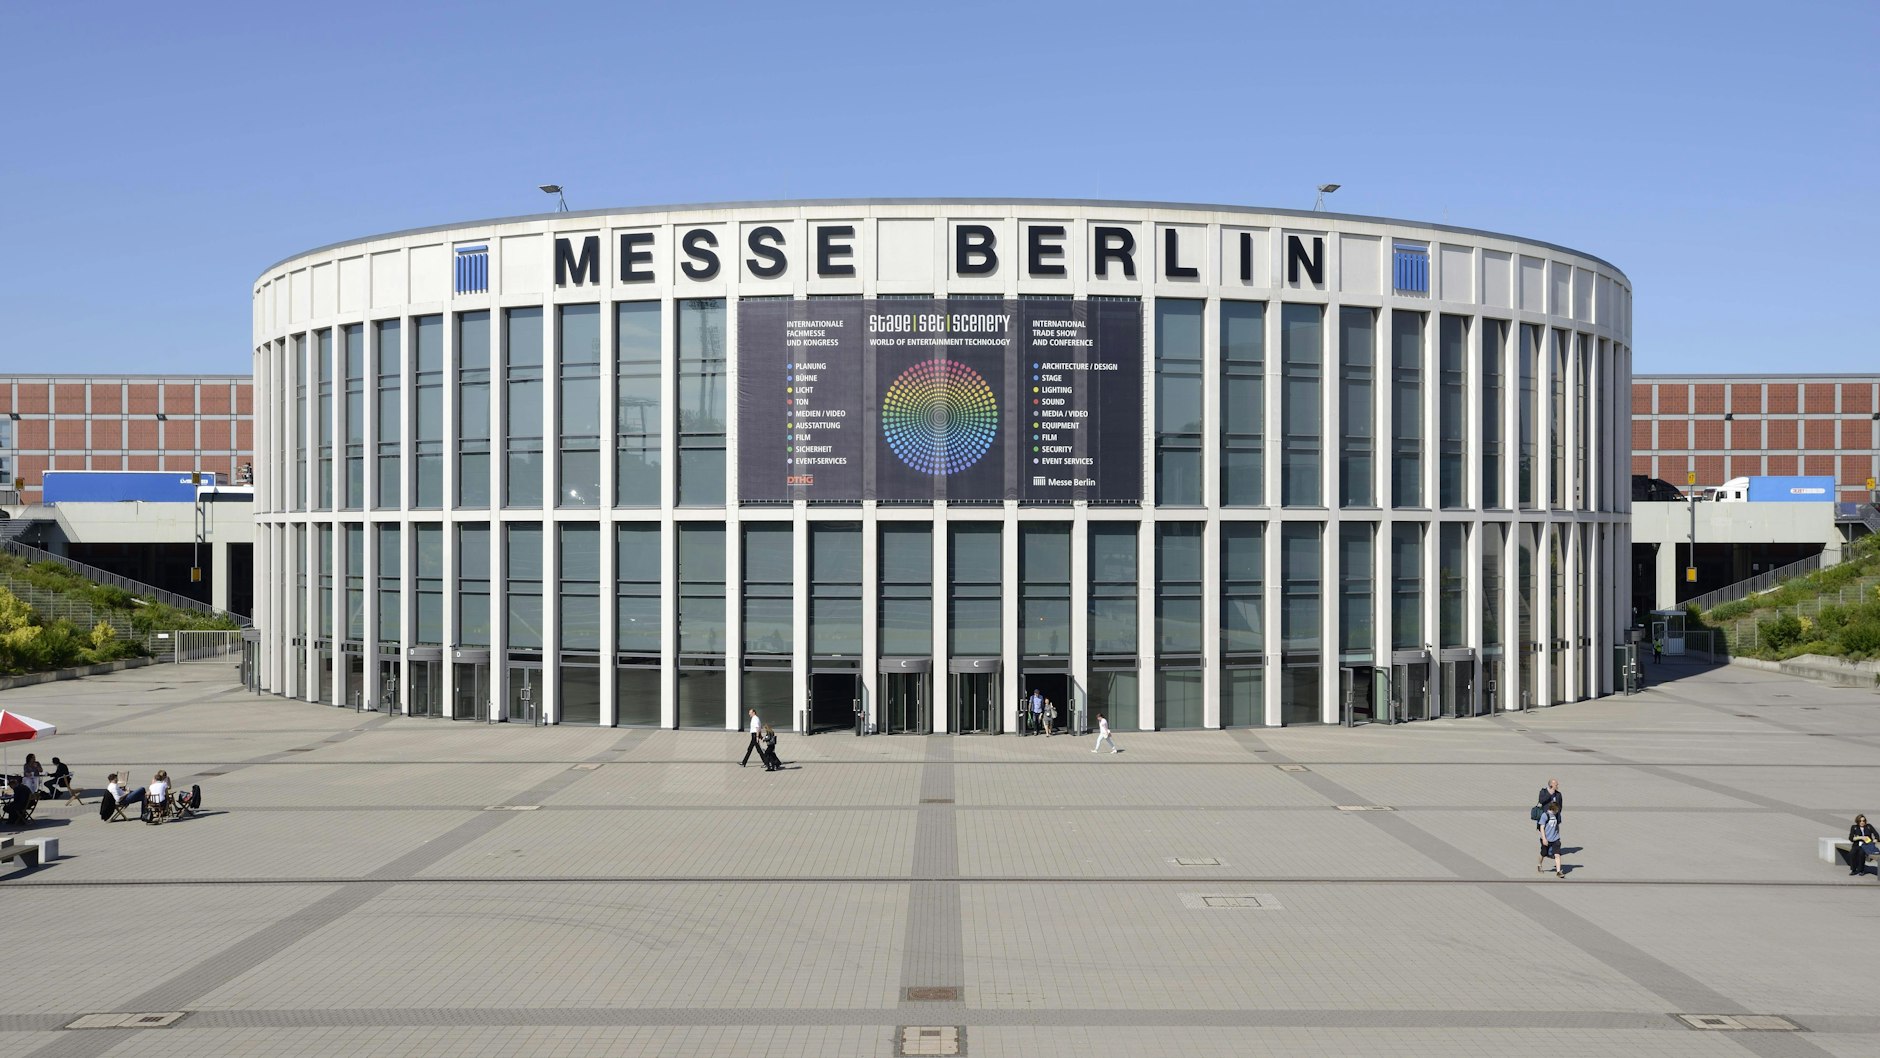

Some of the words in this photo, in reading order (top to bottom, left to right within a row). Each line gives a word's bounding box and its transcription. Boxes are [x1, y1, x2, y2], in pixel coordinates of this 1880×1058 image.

[555, 225, 856, 285] MESSE
[956, 225, 1323, 284] BERLIN
[796, 373, 818, 381] BÜHNE
